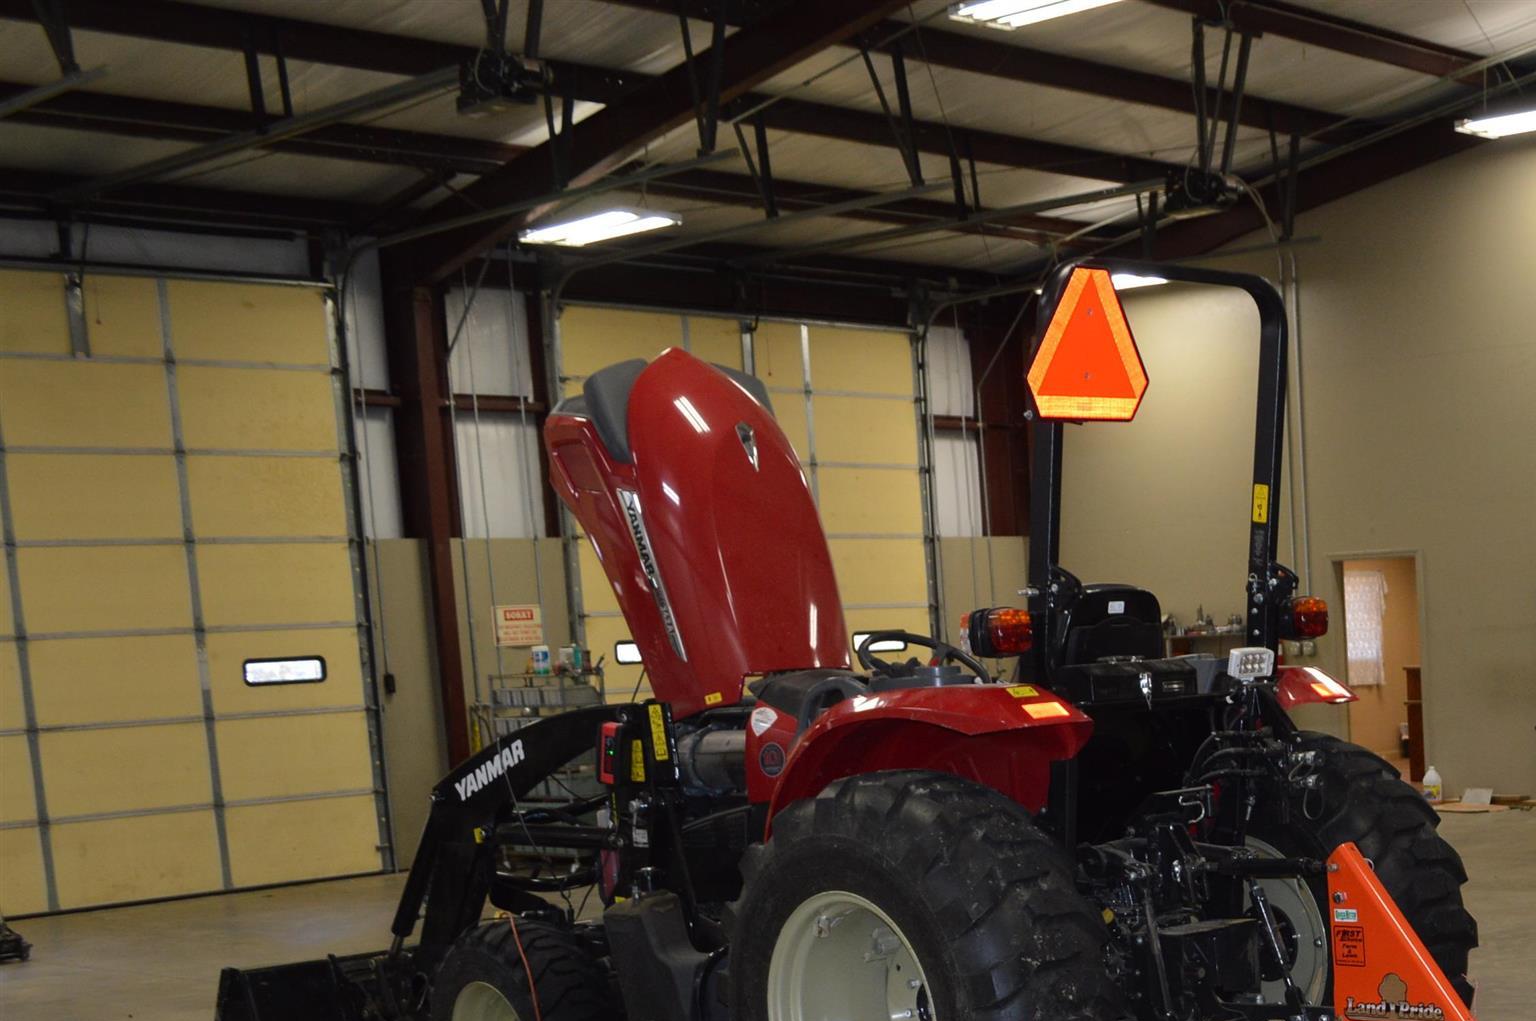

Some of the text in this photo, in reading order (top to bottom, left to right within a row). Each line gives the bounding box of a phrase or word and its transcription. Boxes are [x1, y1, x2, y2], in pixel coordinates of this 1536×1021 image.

[626, 501, 656, 578] YANMAR
[454, 739, 525, 801] YANMAR
[1336, 929, 1362, 938] FIRST
[1347, 997, 1442, 1018] Land Pride
